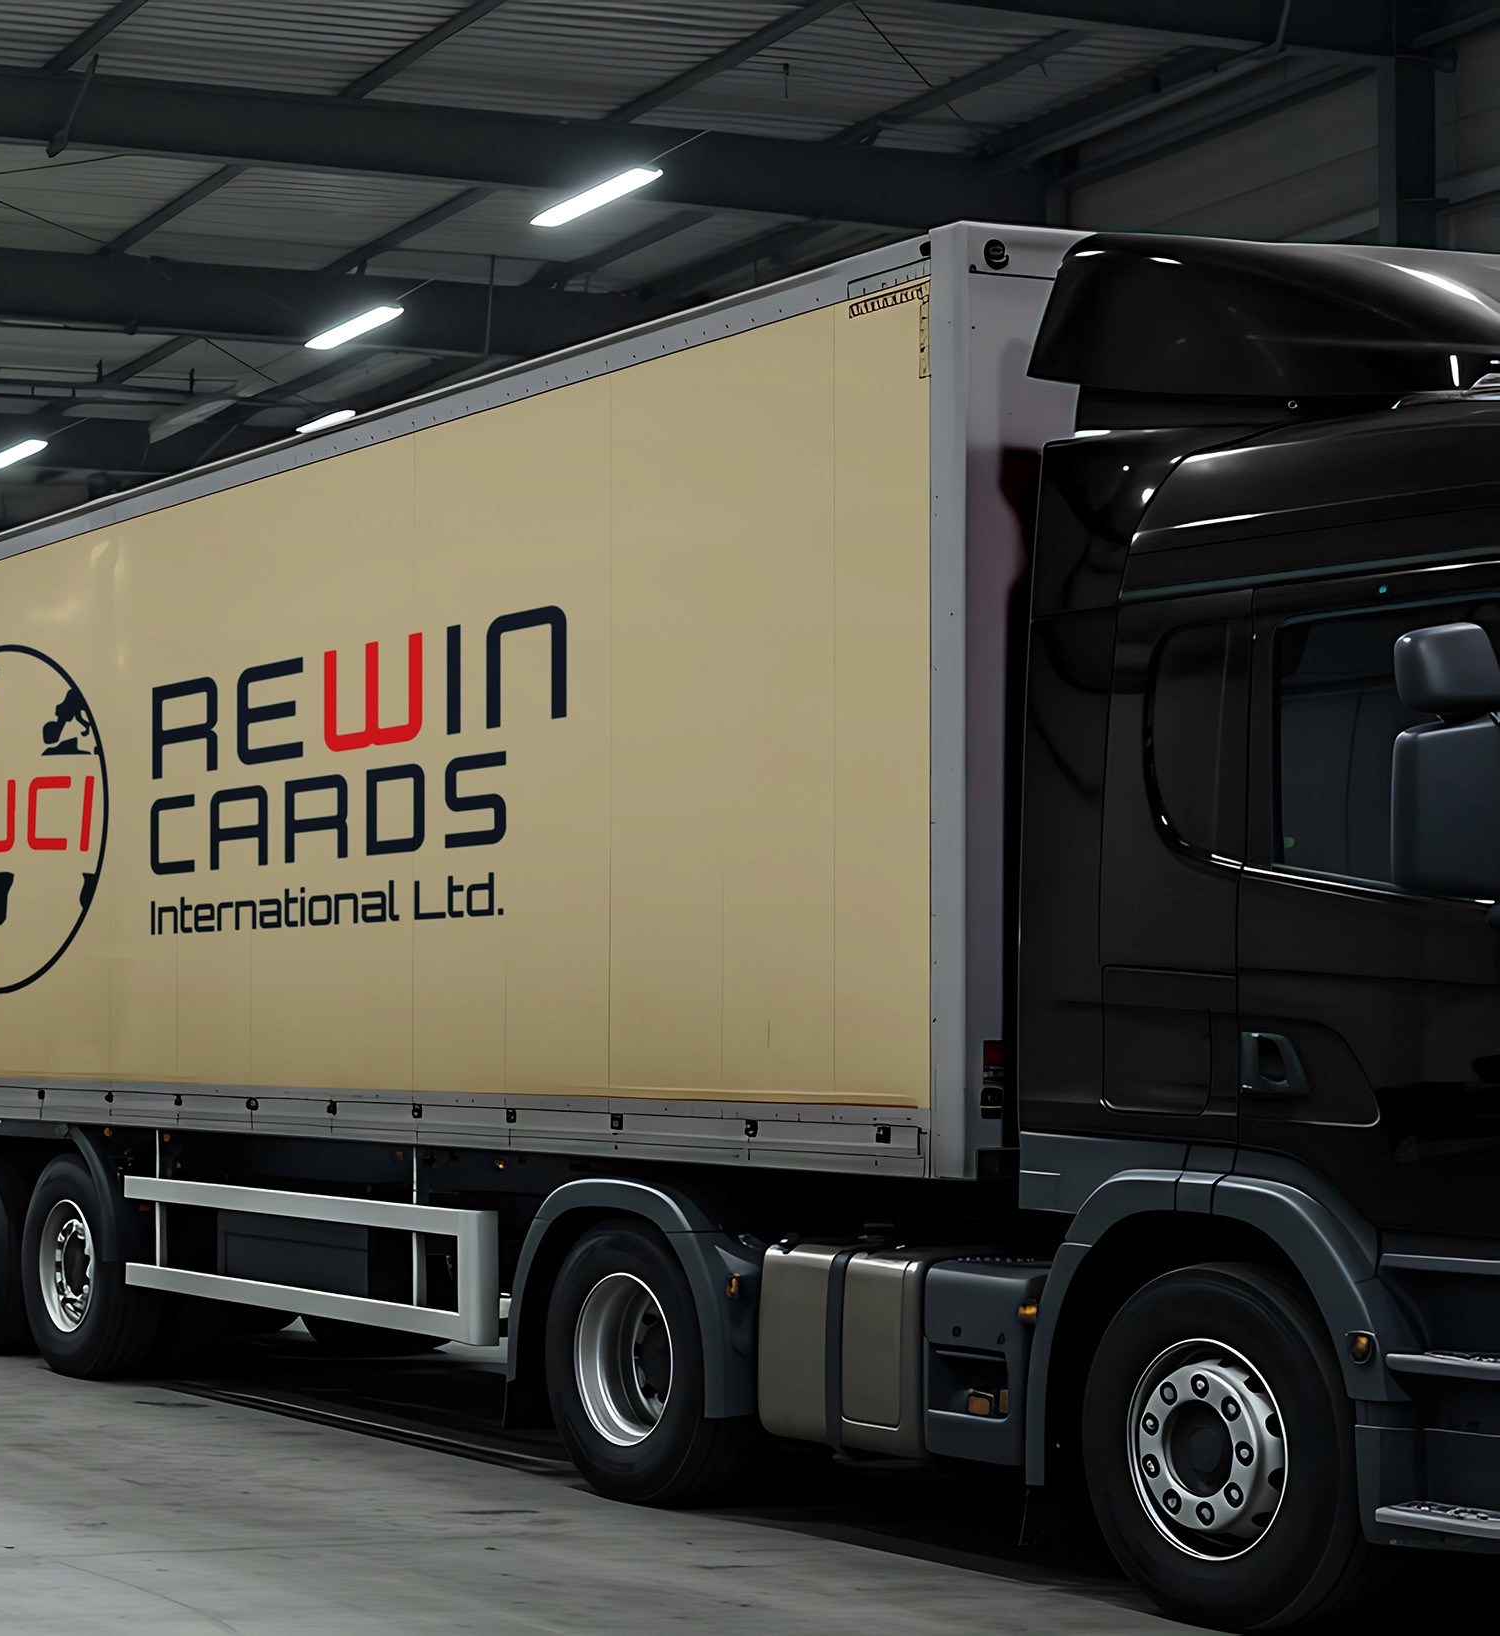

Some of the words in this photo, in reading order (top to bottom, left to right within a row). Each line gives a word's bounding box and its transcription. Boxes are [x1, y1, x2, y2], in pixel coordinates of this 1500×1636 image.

[152, 605, 567, 779] REWIN
[150, 751, 507, 875] CARDS
[150, 880, 400, 936] International
[413, 872, 505, 921] Ltd.
